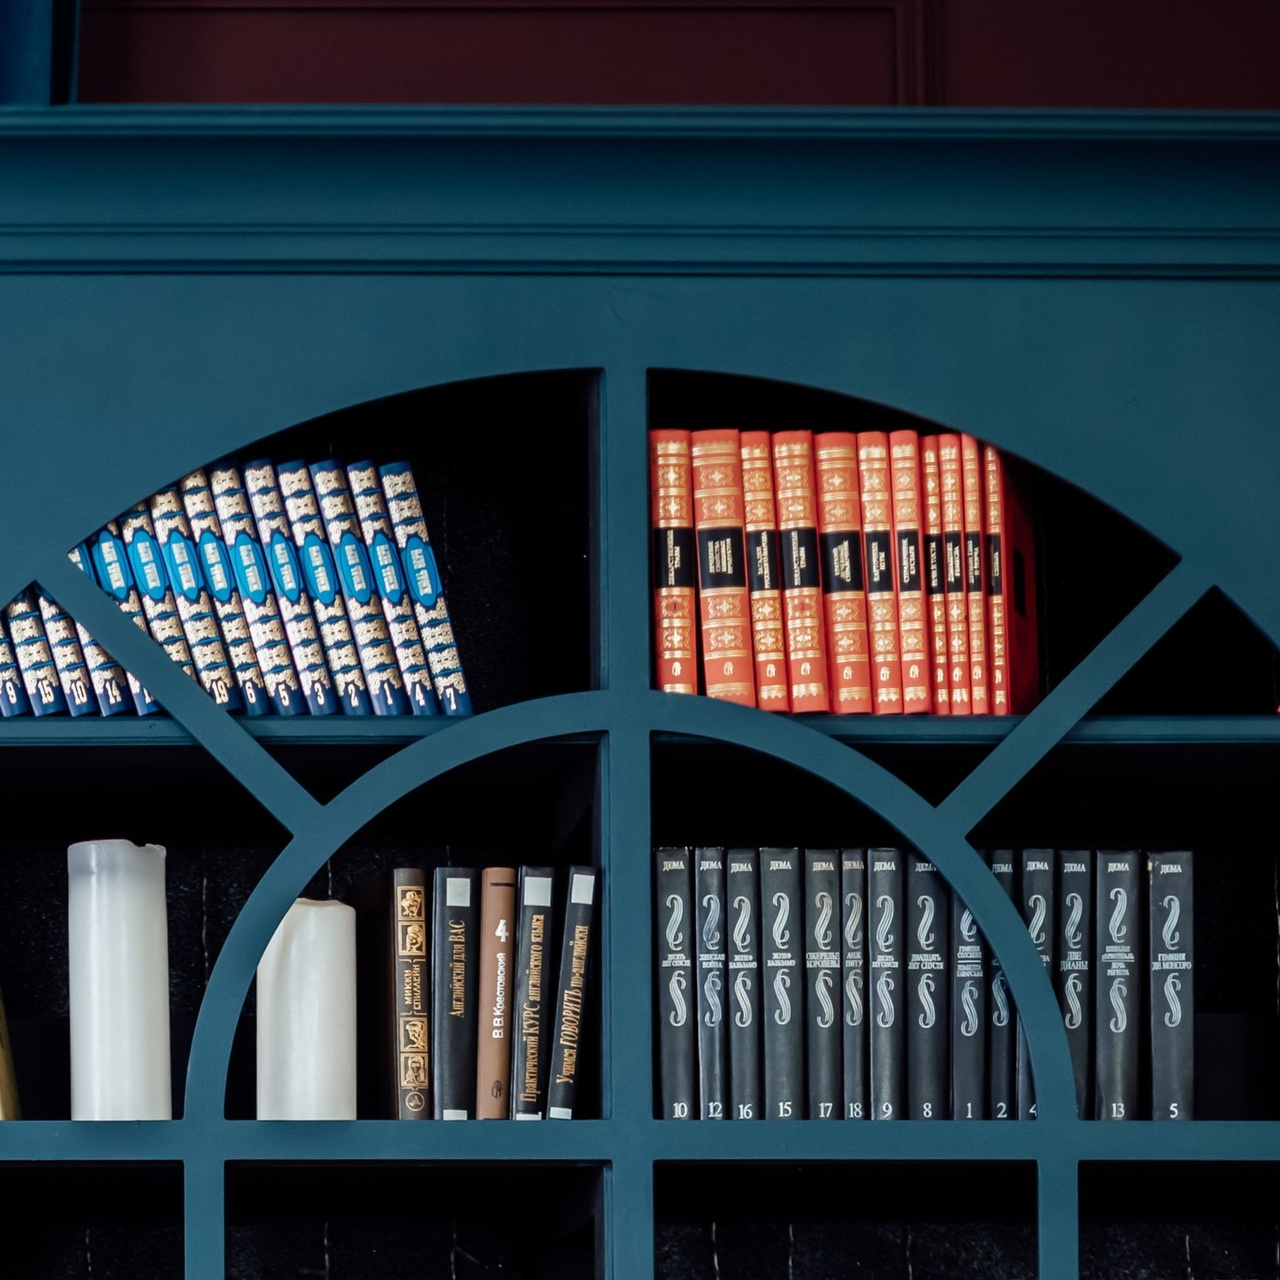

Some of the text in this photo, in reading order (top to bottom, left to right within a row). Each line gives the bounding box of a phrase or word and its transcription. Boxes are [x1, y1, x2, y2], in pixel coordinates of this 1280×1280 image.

[6, 681, 17, 704] 9
[38, 680, 55, 704] 15
[71, 681, 87, 705] 10
[105, 680, 122, 705] 14
[211, 681, 229, 704] 19
[245, 680, 257, 703] 6
[278, 683, 290, 706] 5
[314, 683, 325, 705] 3
[347, 683, 359, 707] 2
[383, 683, 393, 705] 1
[415, 683, 425, 706] 4
[446, 687, 456, 710] 7
[663, 861, 685, 871] ДЮМА
[700, 860, 722, 870] ДЮМА
[730, 863, 752, 873] ДЮМА
[769, 861, 792, 870] ДЮМА
[812, 862, 834, 872] ДЮМА
[843, 861, 865, 870] ДЮМА
[873, 862, 896, 871] ДЮМА
[1027, 861, 1049, 872] ДЮМА
[1064, 863, 1086, 873] ДЮМА
[1108, 862, 1130, 873] ДЮМА
[1160, 864, 1182, 874] ДЮМА
[495, 919, 509, 942] 4
[1067, 952, 1081, 961] ДВЕ
[448, 920, 466, 1018] Английский для ВАС
[1060, 961, 1089, 971] ДИАНЫ
[404, 970, 412, 1005] МИККИ
[412, 964, 421, 1010] СПИЛЛЕЙН
[520, 914, 545, 1102] Практический КУРС английского языка
[556, 925, 589, 1084] Учимся ГОВОРИТЬ по-английски
[673, 1102, 688, 1117] 10
[708, 1102, 723, 1117] 12
[738, 1104, 752, 1118] 16
[778, 1102, 792, 1117] 15
[819, 1103, 833, 1117] 17
[849, 1103, 863, 1118] 18
[882, 1103, 892, 1118] 9
[923, 1103, 932, 1118] 8
[966, 1103, 973, 1118] 1
[997, 1103, 1007, 1118] 2
[1111, 1103, 1125, 1118] 13
[1169, 1103, 1179, 1118] 5
